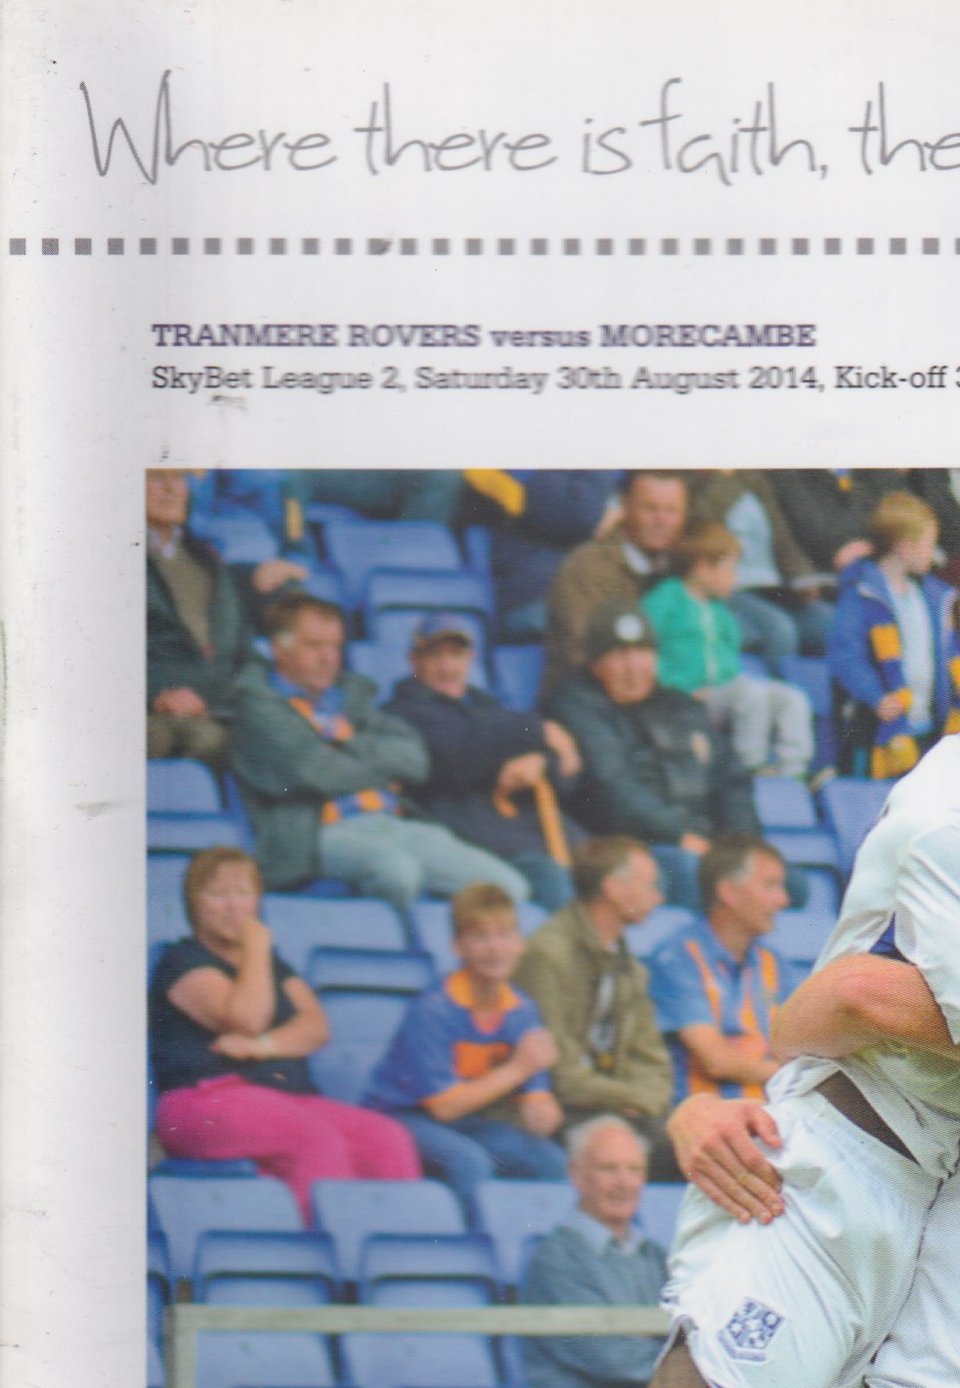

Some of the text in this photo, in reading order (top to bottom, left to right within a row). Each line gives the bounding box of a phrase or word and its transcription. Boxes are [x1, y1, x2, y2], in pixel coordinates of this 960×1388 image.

[79, 69, 336, 185] Where
[354, 82, 556, 175] there
[584, 116, 632, 176] is
[641, 78, 828, 186] faith,
[151, 323, 817, 347] TRANMERE ROVERS versus MORECAMBE
[151, 365, 253, 394] SkyBet
[262, 366, 374, 394] League
[382, 366, 406, 393] 2,
[416, 366, 549, 395] Saturday
[557, 366, 623, 389] 30th
[631, 366, 740, 394] August
[749, 366, 825, 393] 2014,
[834, 365, 947, 390] Kick-off
